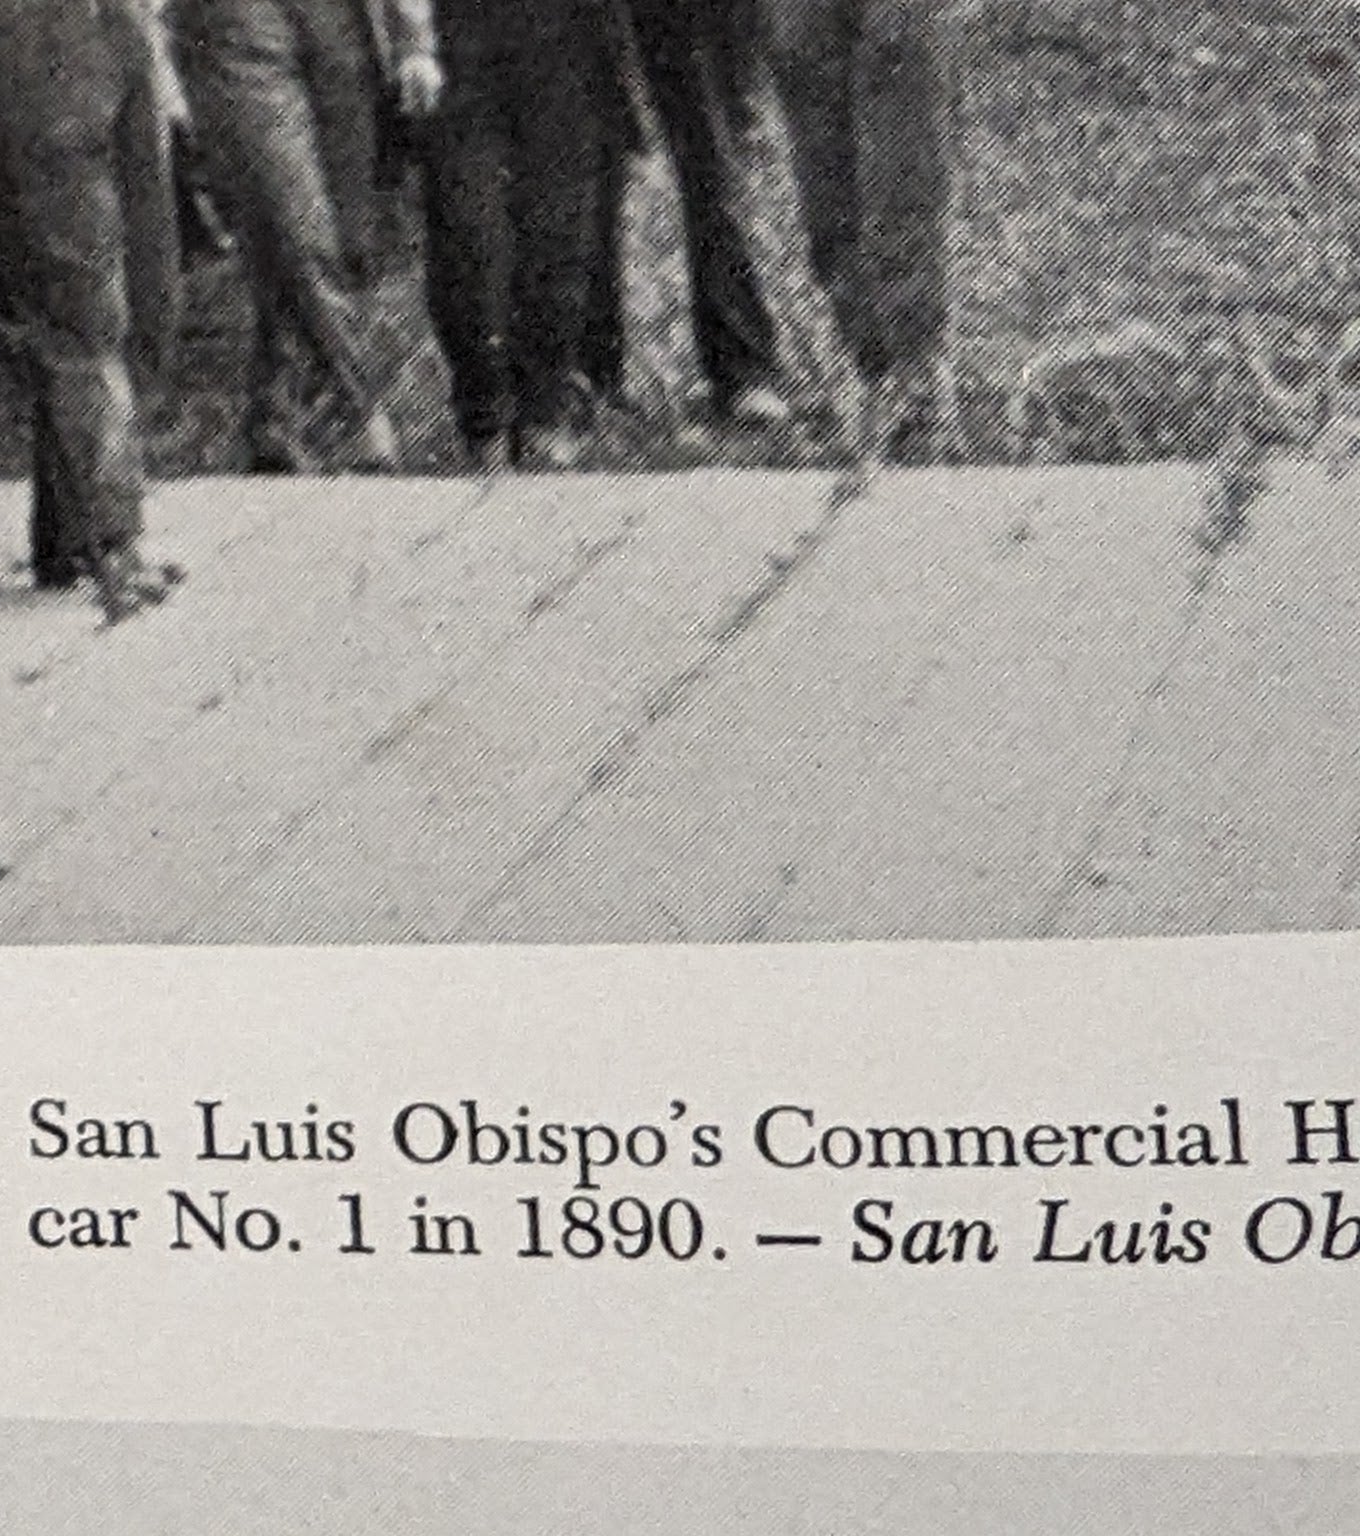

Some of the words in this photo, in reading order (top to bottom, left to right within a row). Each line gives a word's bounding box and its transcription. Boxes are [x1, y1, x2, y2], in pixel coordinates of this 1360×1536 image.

[30, 1098, 161, 1161] San
[194, 1100, 356, 1163] Luis
[392, 1099, 723, 1192] Obispo’s
[753, 1097, 1250, 1170] Commercial
[1283, 1098, 1360, 1166] H
[28, 1206, 139, 1250] car
[167, 1189, 302, 1253] No.
[338, 1192, 376, 1256] 1
[408, 1196, 482, 1256] in
[516, 1195, 727, 1262] 1890.
[851, 1198, 1000, 1266] San
[1032, 1198, 1212, 1266] Luis
[1244, 1189, 1360, 1266] Ob
